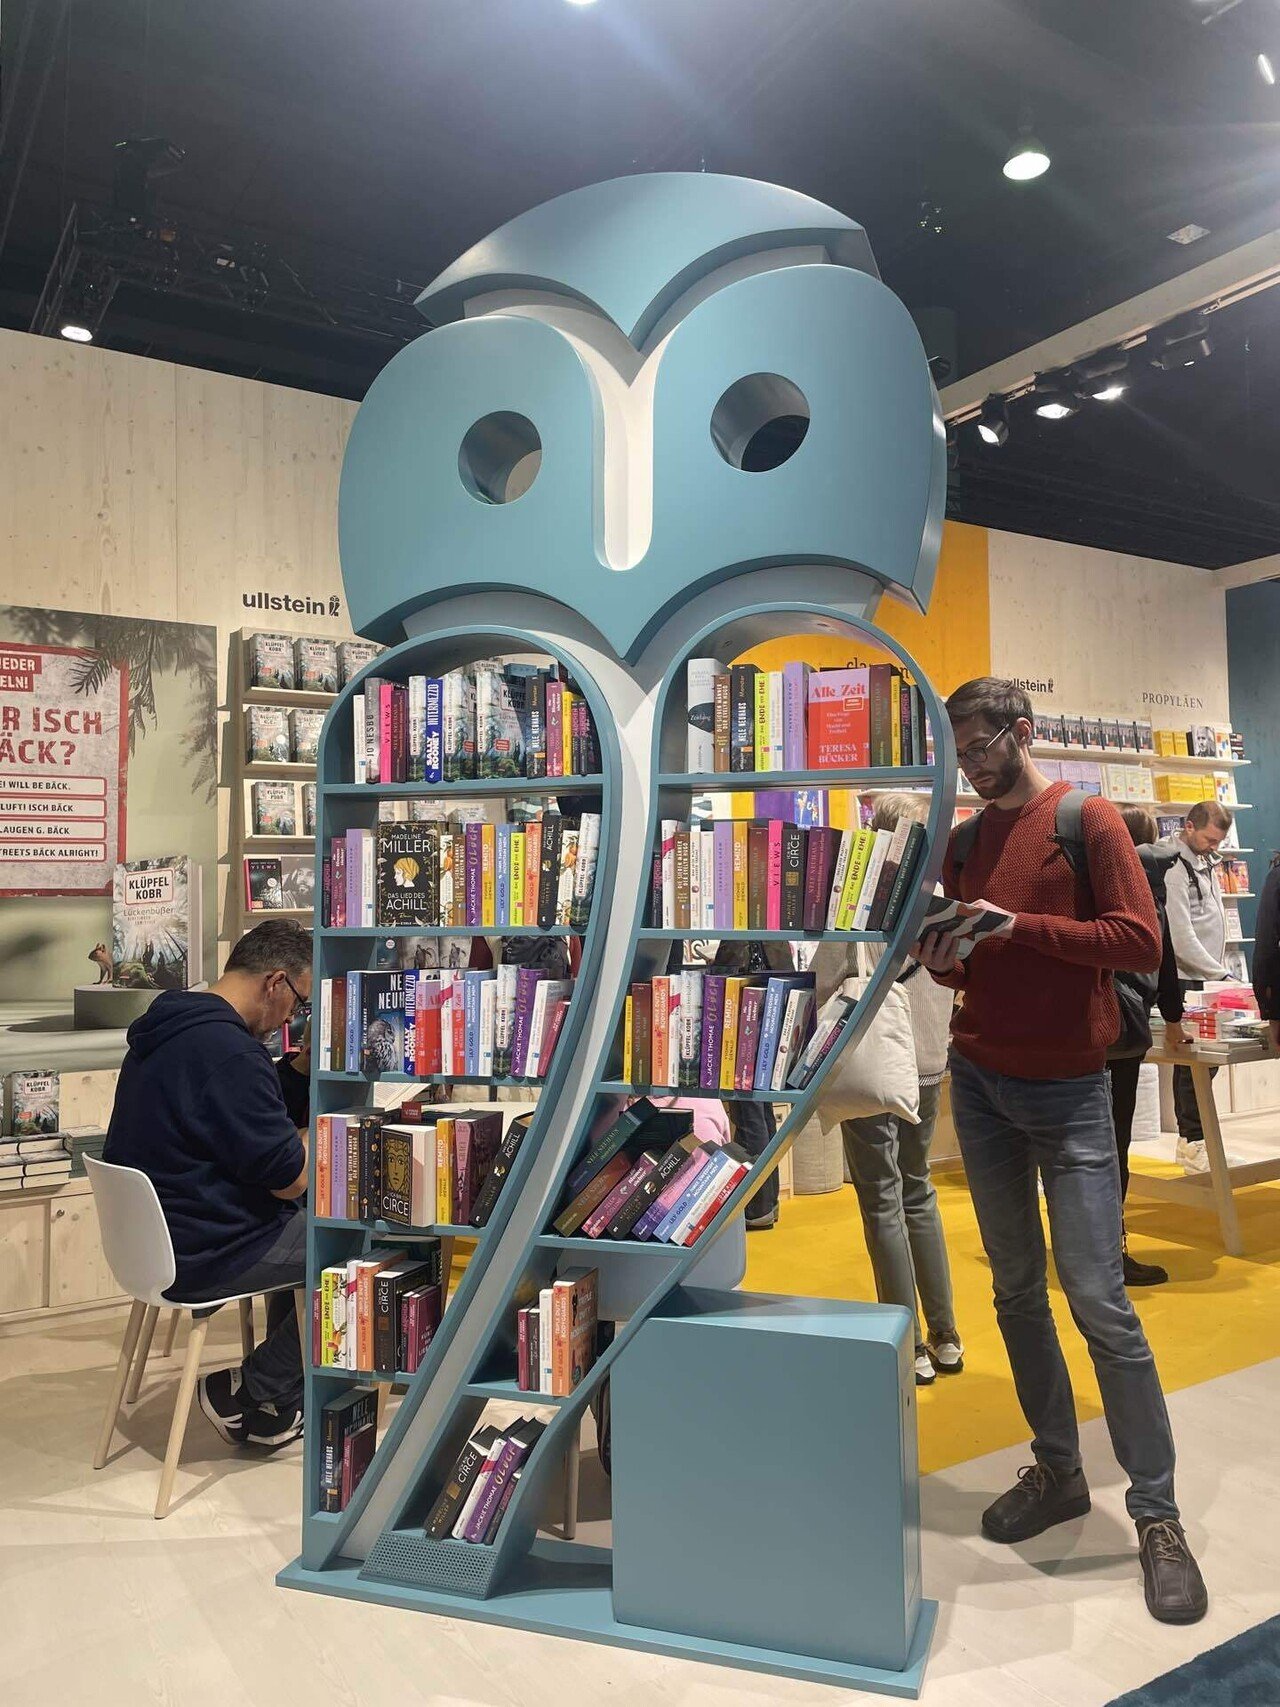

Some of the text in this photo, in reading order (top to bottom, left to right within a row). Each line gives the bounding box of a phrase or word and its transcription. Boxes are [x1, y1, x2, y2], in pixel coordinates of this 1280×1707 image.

[242, 592, 325, 615] ullstein
[812, 684, 866, 698] Alle Zeit
[1142, 692, 1203, 709] PROPYLÄEN
[428, 684, 439, 726] INTERMEZZO
[33, 707, 102, 735] ISCH
[532, 710, 540, 734] NEUHAUS
[738, 730, 746, 742] NELE
[0, 732, 76, 766] ÄCK?
[367, 748, 375, 756] JO
[432, 731, 440, 770] ROONEY
[818, 753, 858, 763] BÜCKER
[820, 744, 857, 753] TERESA
[9, 781, 71, 791] WILL BE BÄCK.
[28, 804, 49, 812] ISCH
[51, 803, 74, 812] BÄCK
[36, 827, 45, 835] G.
[48, 826, 70, 835] BÄCK
[546, 825, 554, 850] ACHILL
[33, 847, 56, 857] BÄCK
[58, 849, 98, 858] ALRIGHT!
[382, 840, 431, 853] MILLER
[790, 834, 800, 868] CIRCE
[809, 842, 817, 874] NEUHAUS
[851, 836, 866, 880] ENDE EHE
[129, 876, 169, 890] KLÜPFEL
[136, 889, 162, 900] KOBR
[386, 899, 427, 911] ACHILL
[390, 974, 403, 991] NE
[405, 974, 416, 1017] INTERMEZZO
[505, 1134, 520, 1158] ACHILL
[660, 1156, 681, 1179] ACHILL
[382, 1196, 409, 1217] CIRCE
[669, 1202, 688, 1224] LILY GOLD
[381, 1281, 389, 1313] CIRCE
[326, 1446, 334, 1469] NEUHAUS
[458, 1452, 478, 1483] CIRCE
[475, 1485, 497, 1530] JACKIE THOMAE
